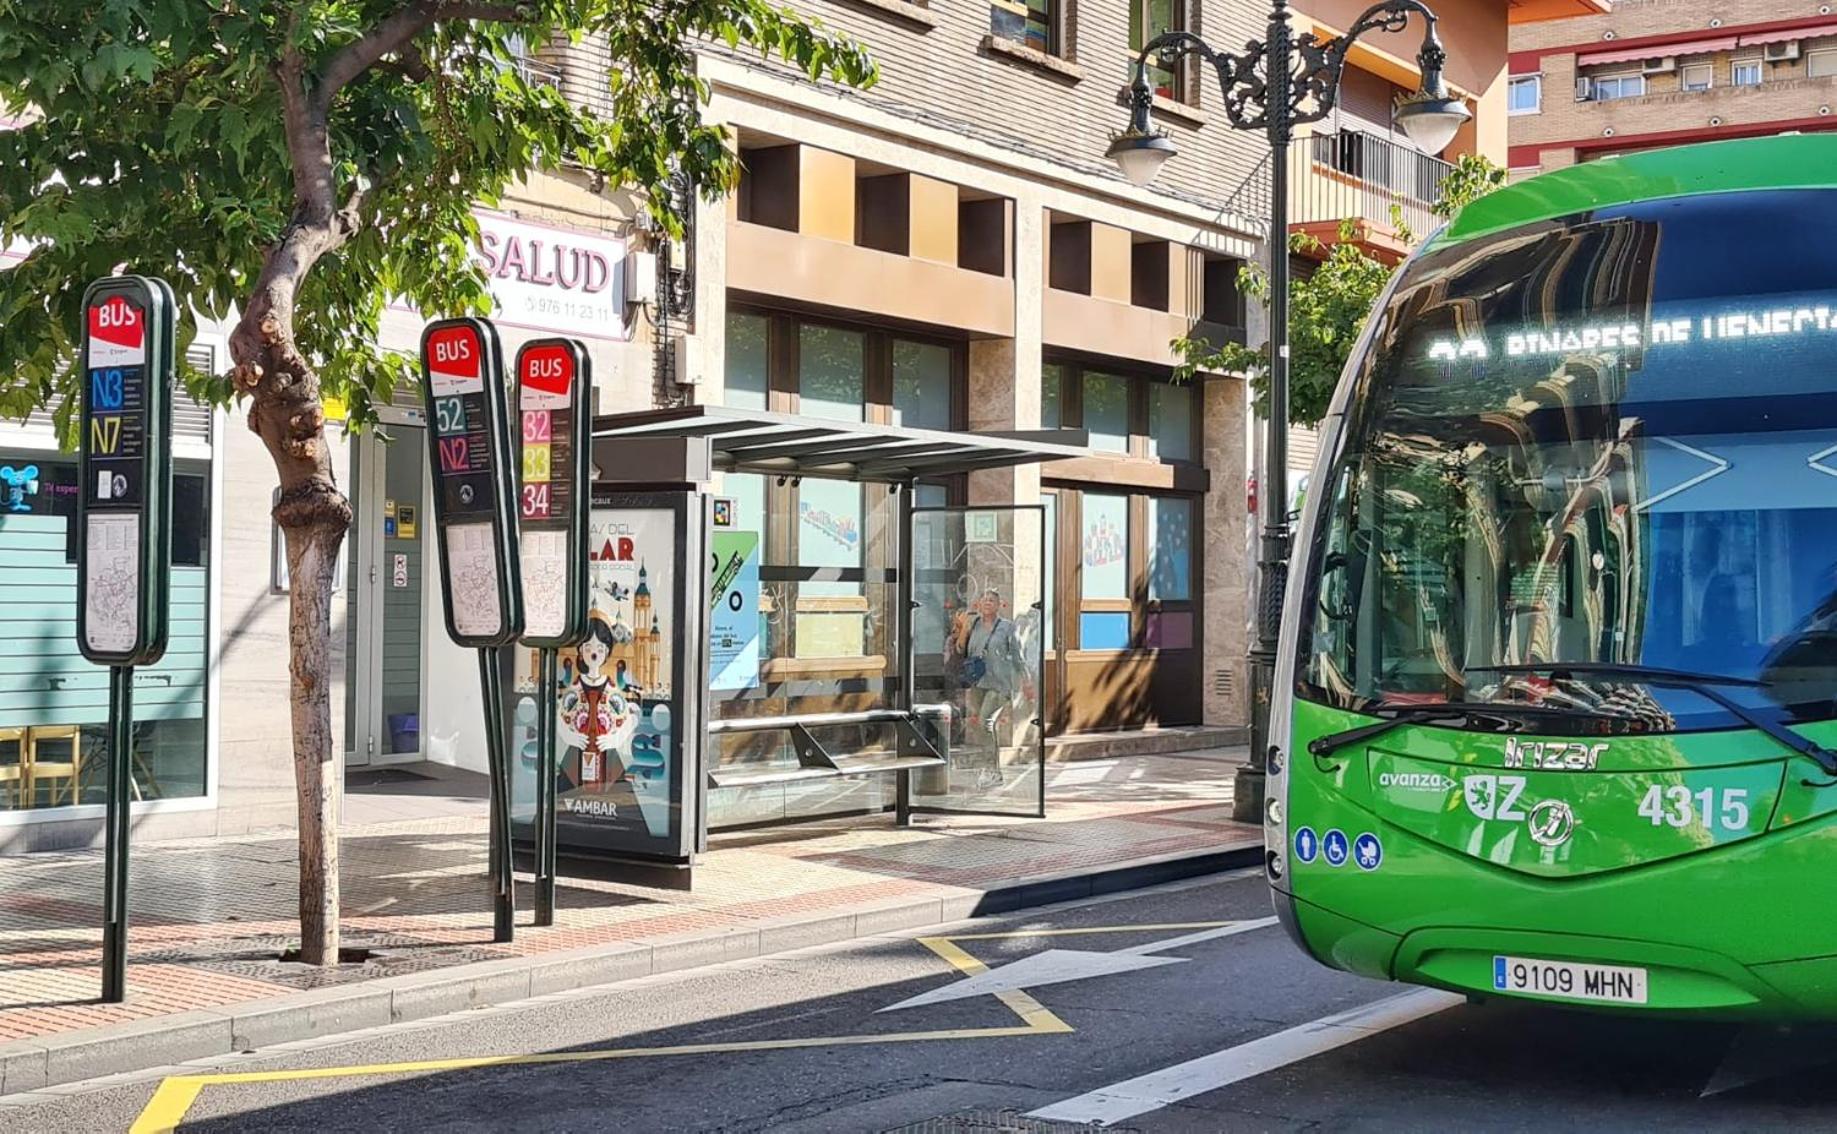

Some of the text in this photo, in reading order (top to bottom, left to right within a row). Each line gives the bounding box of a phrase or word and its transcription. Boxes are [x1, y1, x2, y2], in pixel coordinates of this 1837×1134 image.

[481, 230, 611, 294] SALUD
[99, 303, 136, 328] BUS
[538, 297, 609, 322] 976 11 23 11
[435, 338, 471, 363] BUS
[529, 358, 563, 378] BUS
[92, 369, 123, 408] N3
[435, 397, 464, 432] 52
[523, 411, 551, 442] 32
[91, 415, 122, 455] N7
[439, 437, 470, 471] N2
[523, 446, 549, 478] 33
[523, 484, 550, 517] 34
[608, 523, 635, 535] DEL
[1503, 736, 1610, 771] Irizar
[1379, 772, 1441, 787] avanza
[574, 799, 618, 817] AMBAR
[1637, 783, 1750, 831] 4315
[1513, 963, 1574, 993] 9109
[1584, 969, 1633, 998] MHN
